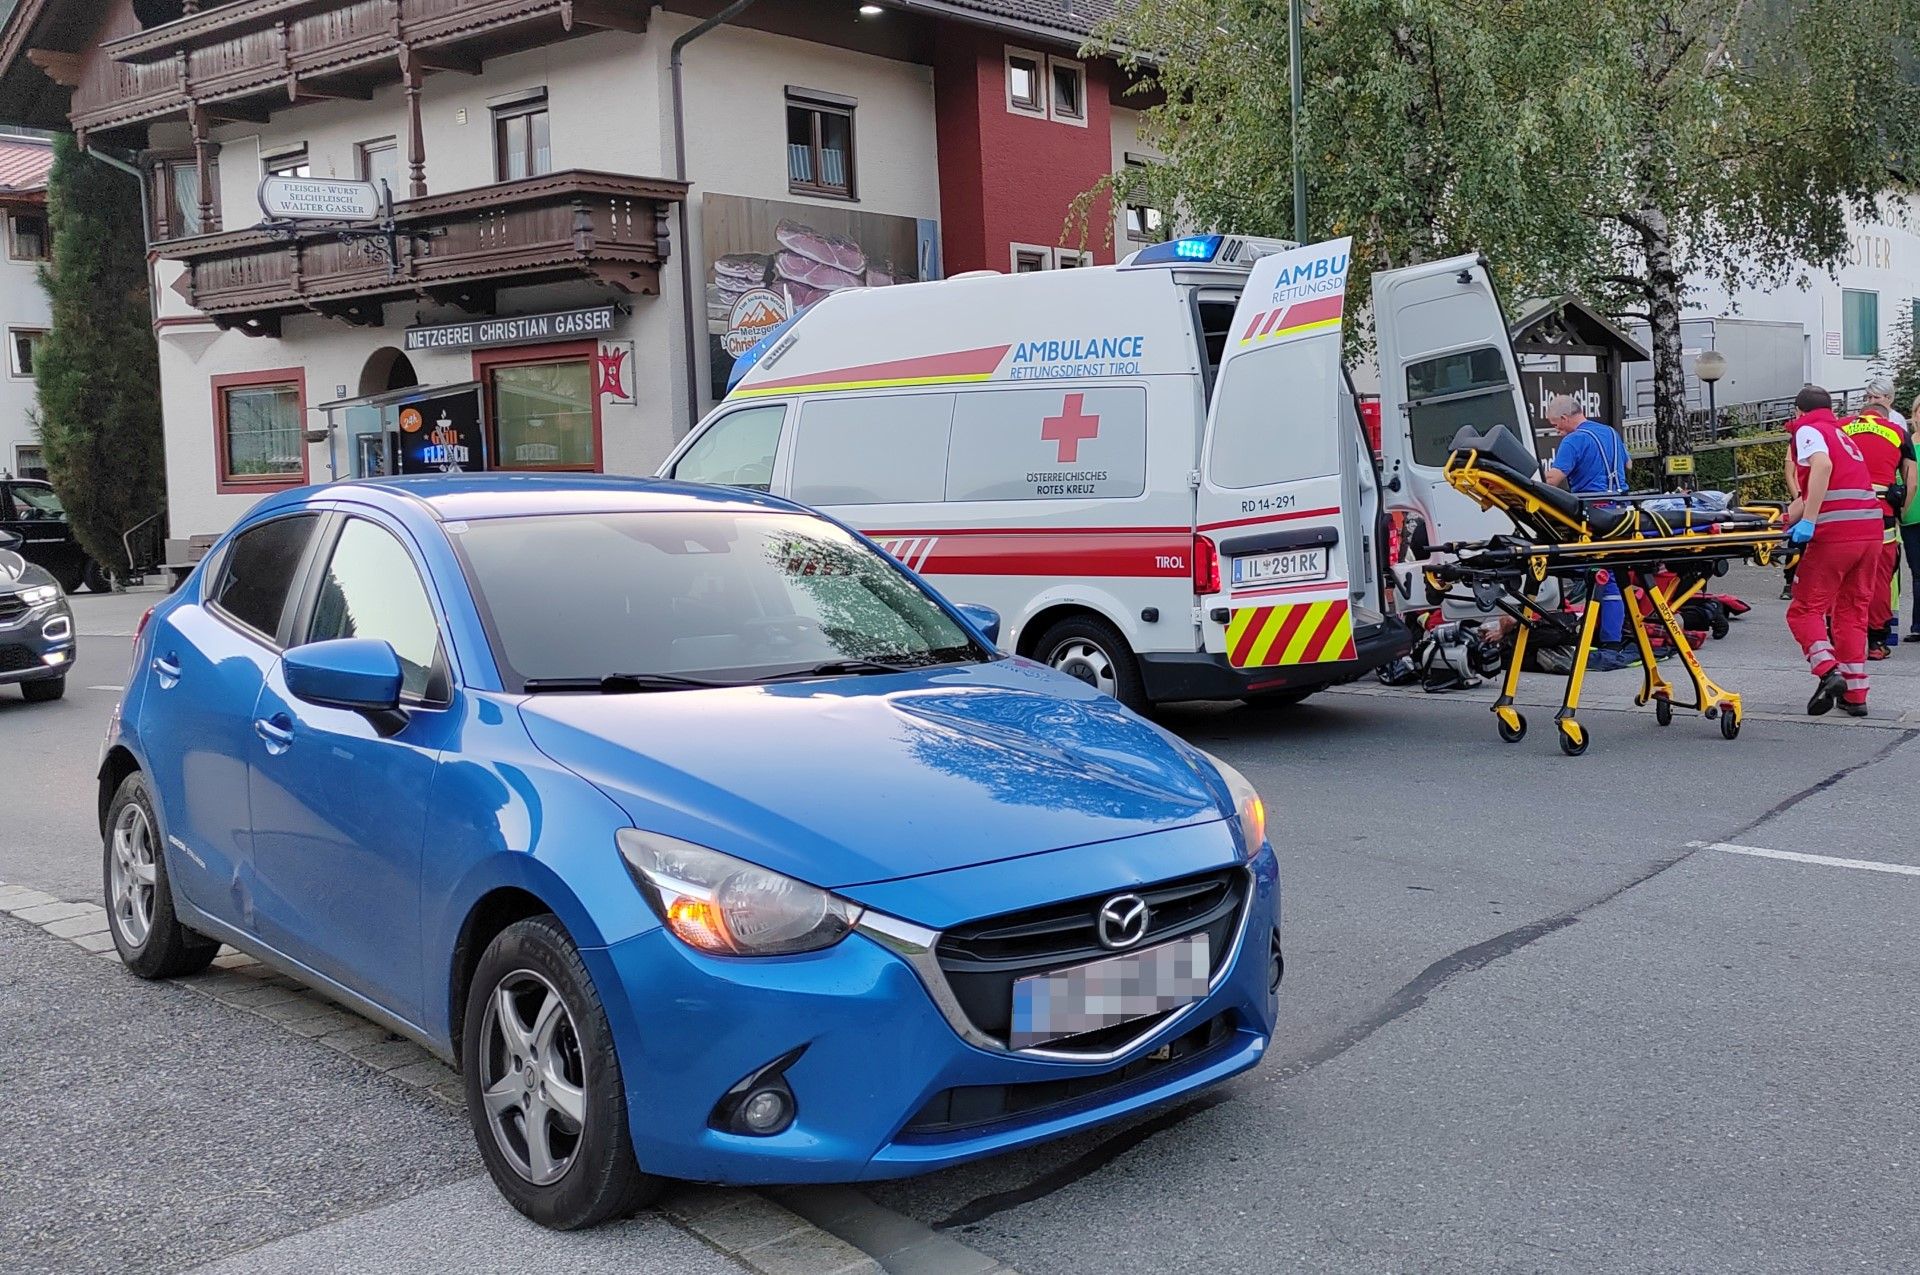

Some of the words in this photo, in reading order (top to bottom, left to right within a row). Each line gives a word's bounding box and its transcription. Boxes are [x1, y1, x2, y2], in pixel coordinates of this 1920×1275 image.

[284, 183, 320, 193] FLEISCH
[328, 186, 359, 195] WURST
[289, 193, 353, 203] SELCHFLEISCH
[280, 201, 323, 212] WALTER
[326, 204, 364, 213] GASSER
[1275, 254, 1347, 289] AMBU
[480, 317, 548, 341] CHRISTIAN
[555, 311, 611, 334] GASSER
[1013, 336, 1144, 363] AMBULANCE
[1010, 362, 1105, 379] RETTUNGSDIENST
[1109, 361, 1140, 375] TIROL
[1026, 471, 1107, 483] ÖSTERREICHISCHES
[1037, 484, 1064, 495] ROTES
[1066, 484, 1095, 494] KREUZ
[1242, 500, 1256, 514] RD
[1259, 495, 1296, 511] 14-291
[1155, 555, 1185, 569] TIROL
[1249, 560, 1262, 578] IL
[1659, 602, 1681, 636] stryker
